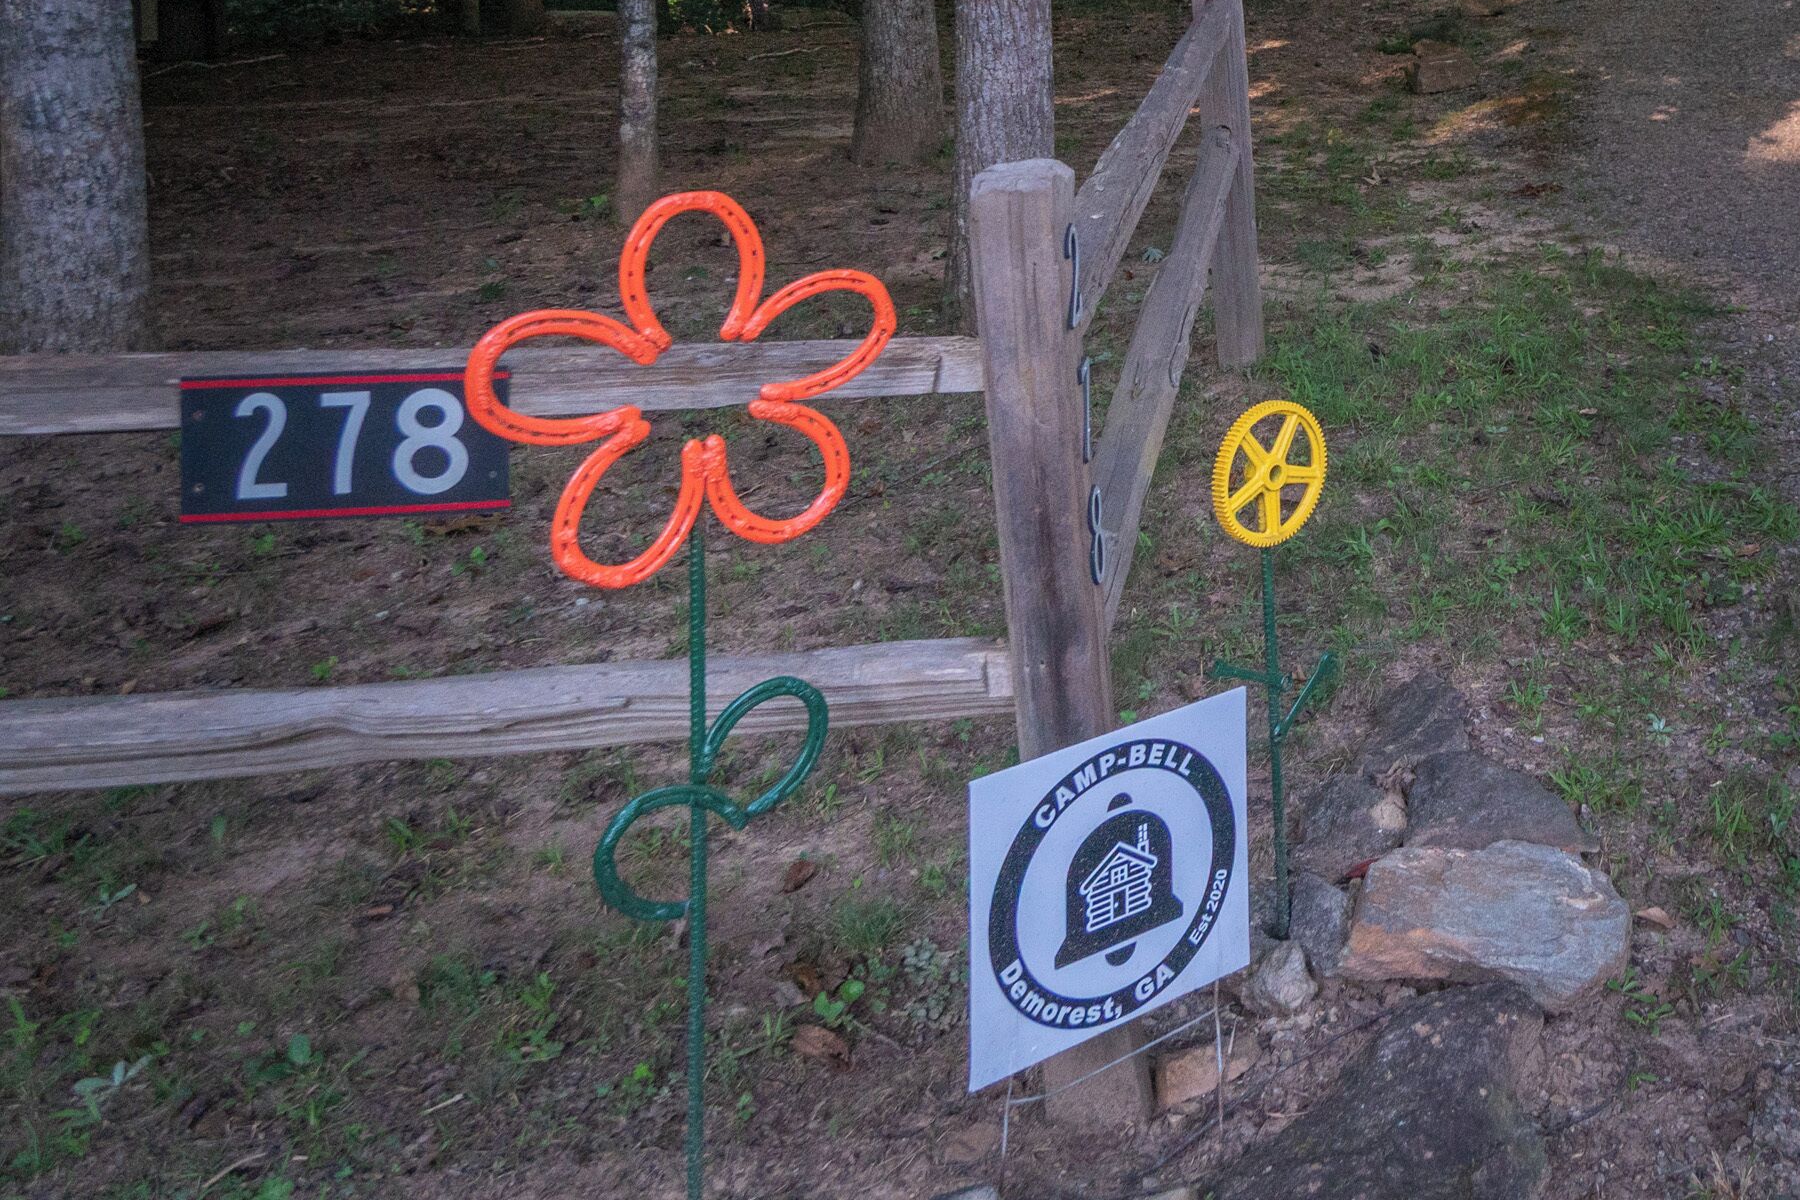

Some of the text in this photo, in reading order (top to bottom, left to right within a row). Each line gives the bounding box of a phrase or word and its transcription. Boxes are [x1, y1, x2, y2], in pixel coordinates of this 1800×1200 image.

[234, 387, 470, 500] 278
[1034, 743, 1194, 829] CAMP-BELL
[1188, 868, 1228, 946] Est 2020
[1000, 958, 1176, 1026] Demorest, GA
